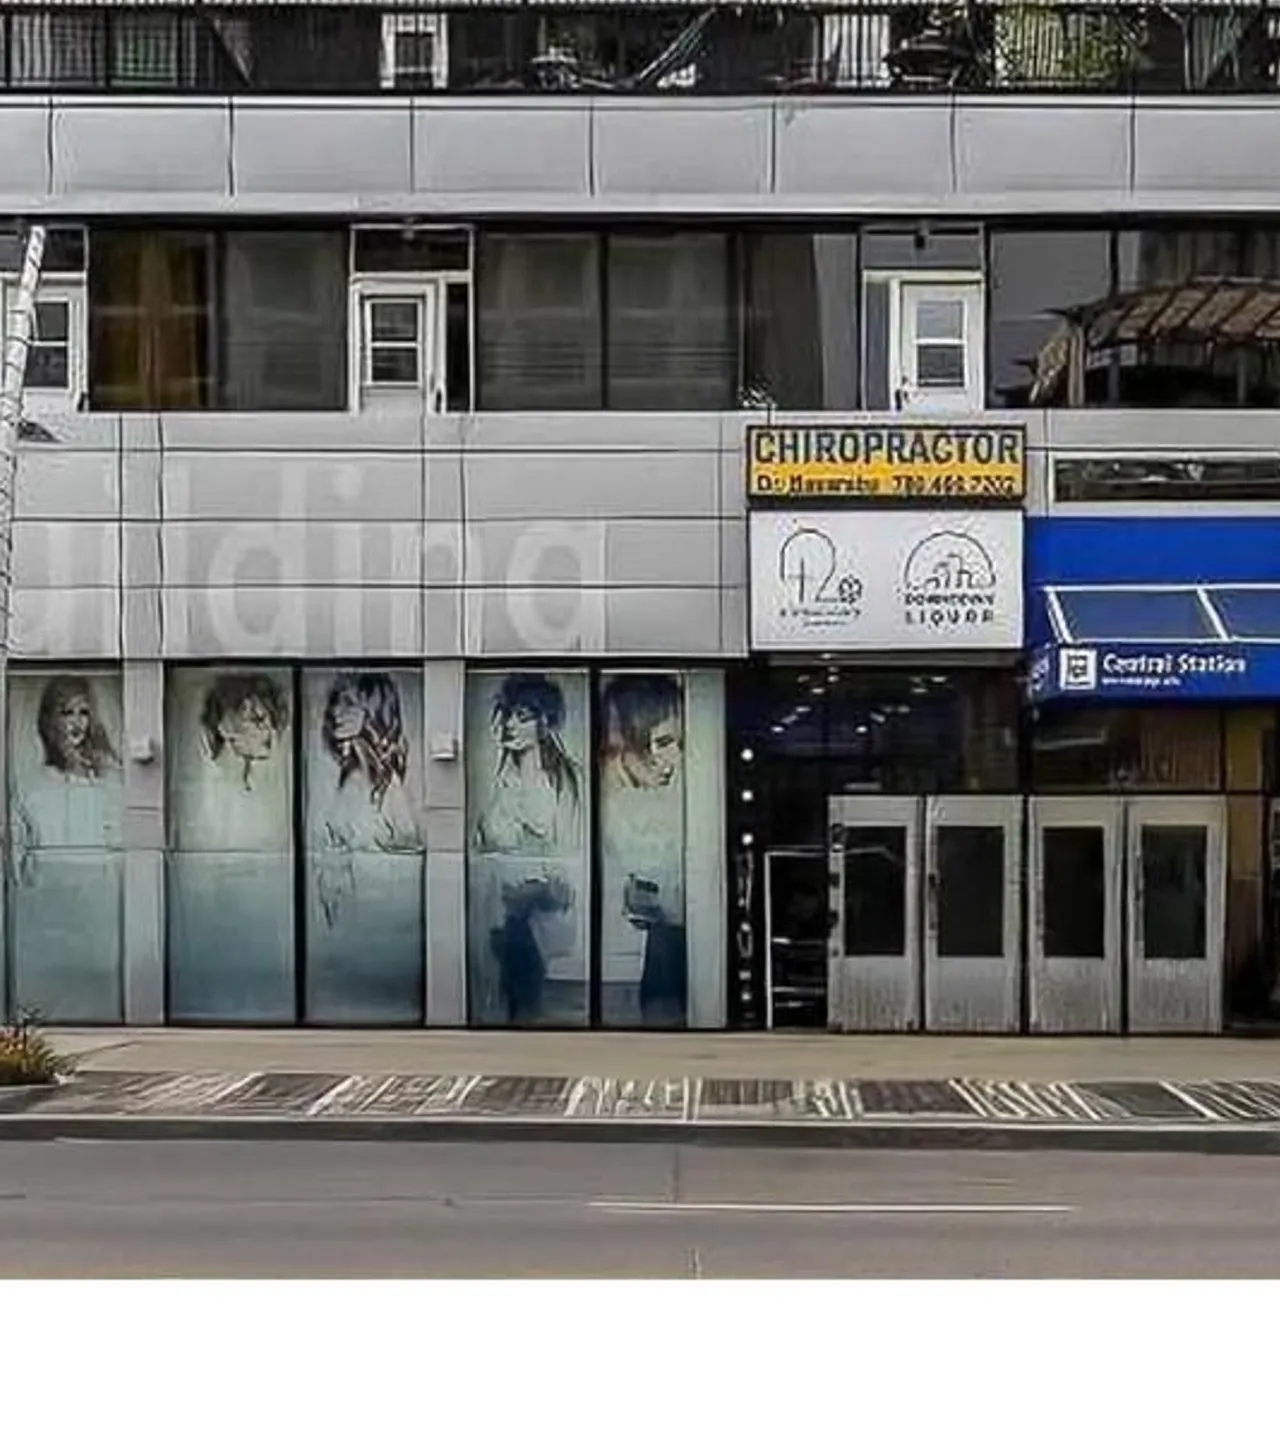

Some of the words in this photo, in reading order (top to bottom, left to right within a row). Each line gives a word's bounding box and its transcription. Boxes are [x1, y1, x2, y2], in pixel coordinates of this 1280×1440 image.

[755, 431, 1019, 464] CHIROPRACTOR
[905, 610, 995, 626] LIQUOR
[1177, 652, 1247, 674] Station
